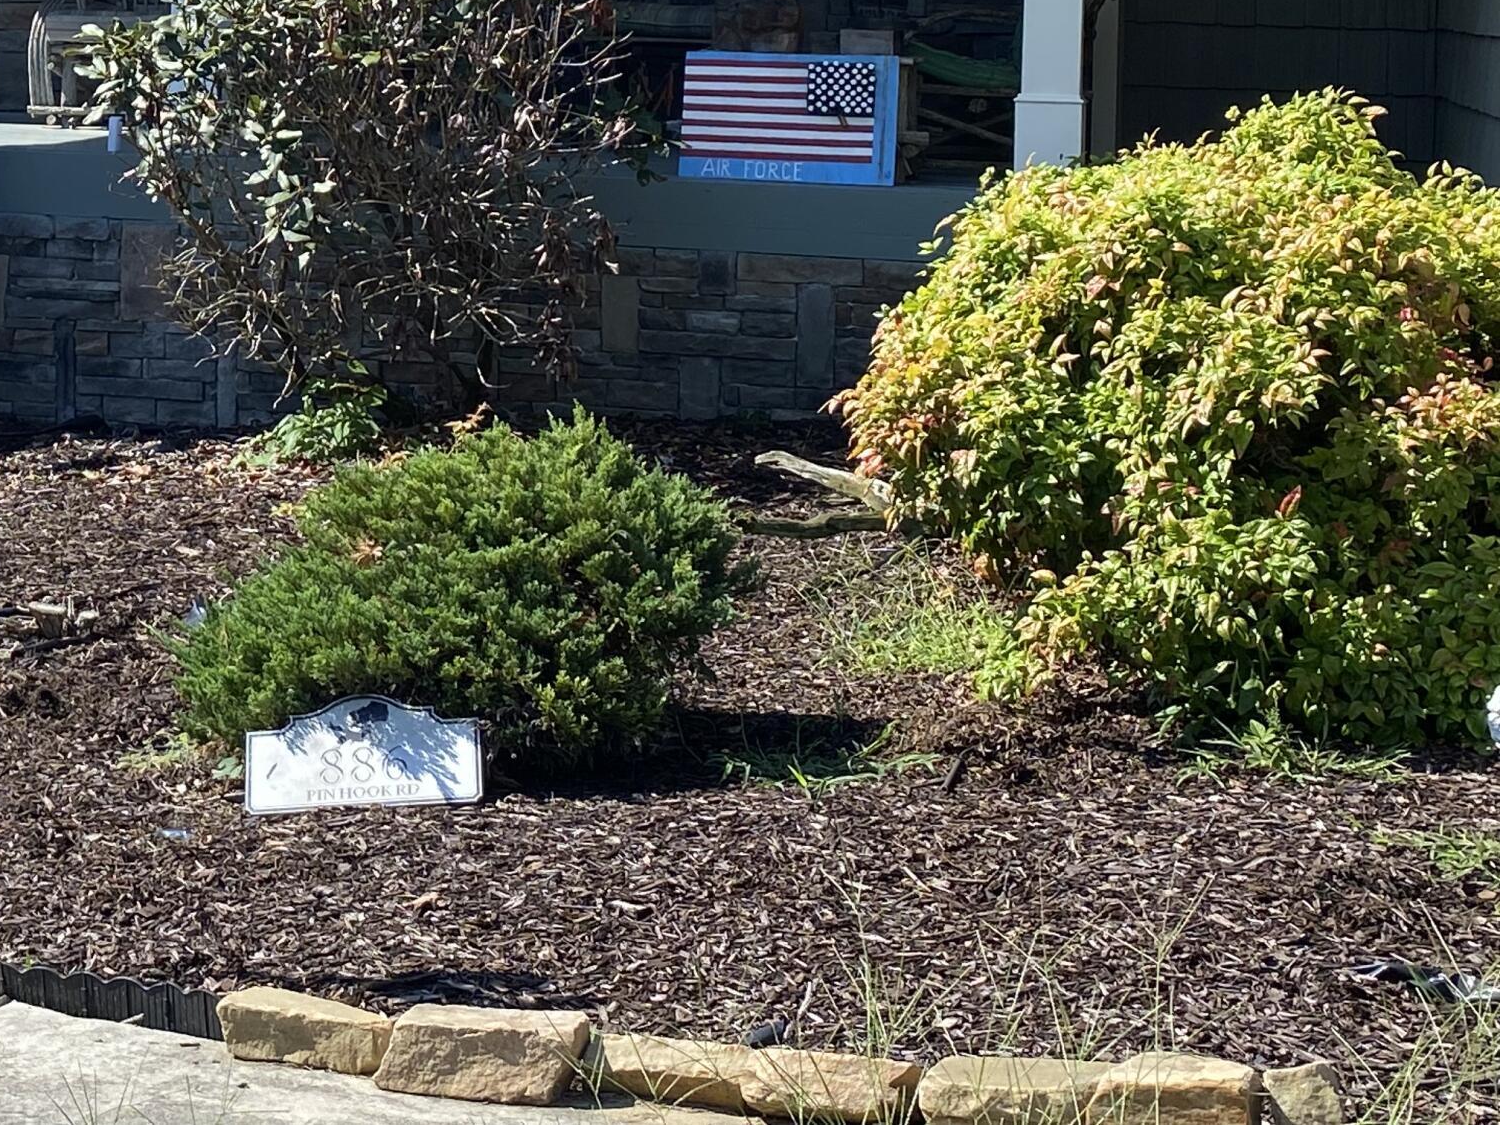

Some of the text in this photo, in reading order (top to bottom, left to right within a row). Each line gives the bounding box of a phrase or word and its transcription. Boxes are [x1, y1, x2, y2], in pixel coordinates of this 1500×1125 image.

[700, 158, 804, 182] AIR FORCE
[320, 746, 409, 784] 886
[307, 782, 421, 802] PIN HOOK RD
